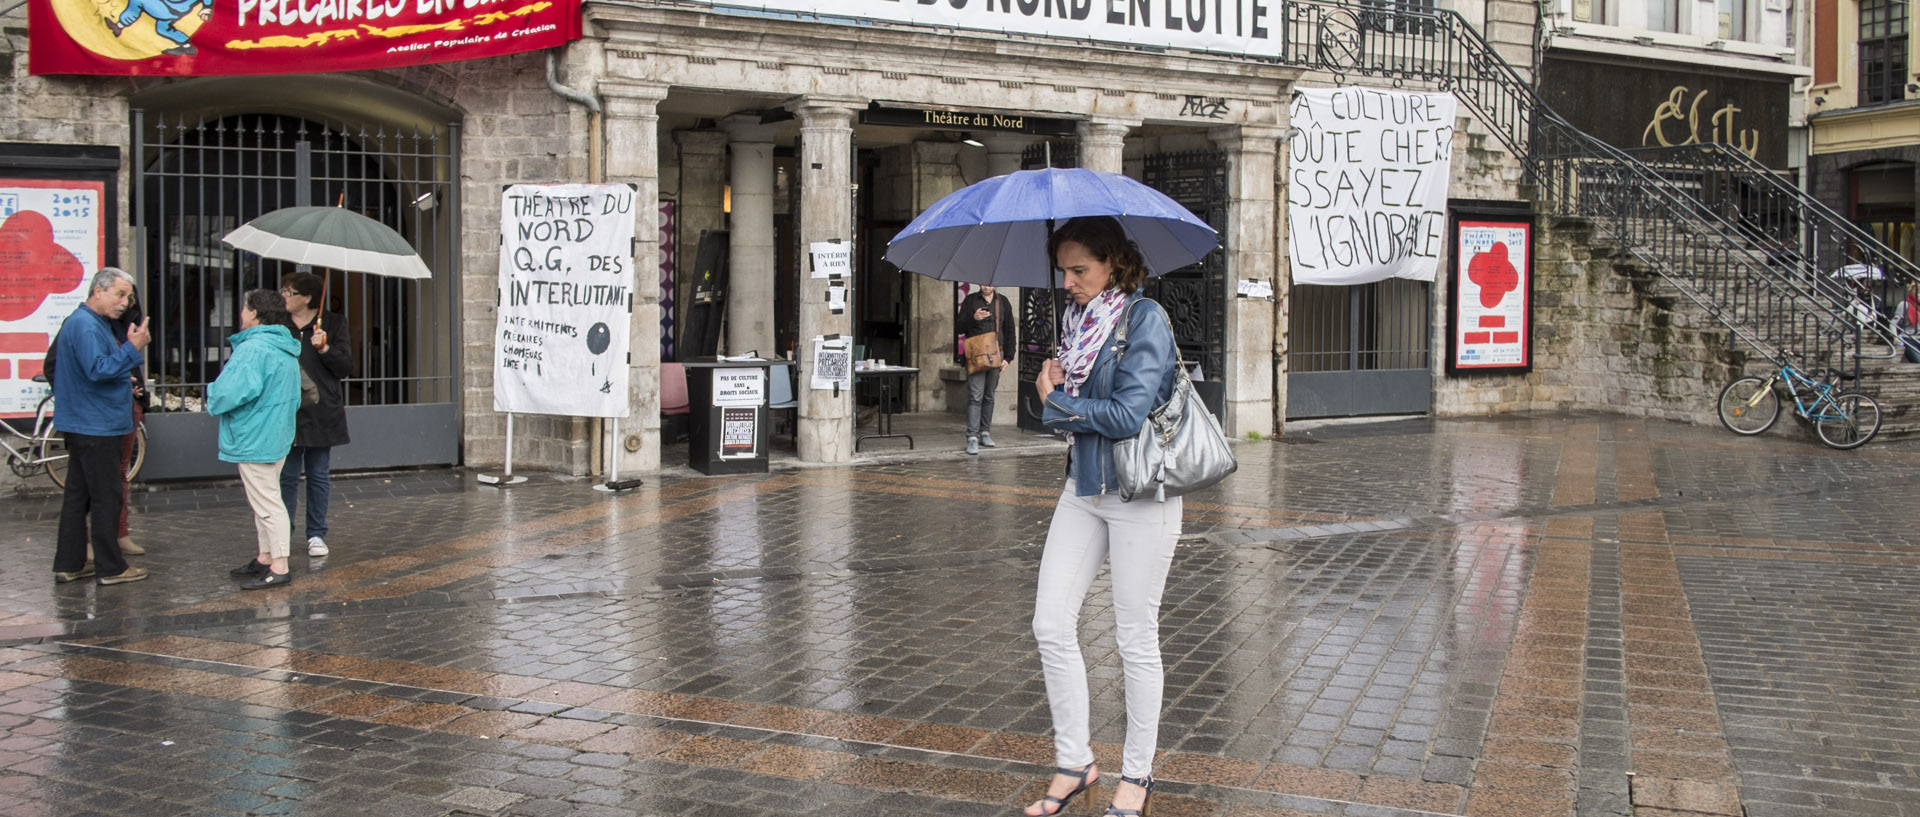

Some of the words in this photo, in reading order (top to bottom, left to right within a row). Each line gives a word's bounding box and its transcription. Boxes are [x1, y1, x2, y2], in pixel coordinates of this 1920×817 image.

[387, 42, 431, 54] Atelier
[434, 36, 490, 49] Populaire
[494, 32, 507, 40] de
[511, 23, 556, 38] Création
[1331, 90, 1442, 125] CULTURE
[923, 110, 970, 125] Théâtre
[973, 114, 988, 126] du
[992, 114, 1023, 129] Nord
[1289, 168, 1423, 208] SSAYEZ
[53, 193, 91, 205] 2014
[601, 191, 631, 216] DU
[53, 207, 90, 218] 2015
[518, 218, 594, 243] NORD
[587, 255, 622, 275] DES
[818, 251, 848, 260] INTÉRIM
[830, 260, 846, 268] RIEN
